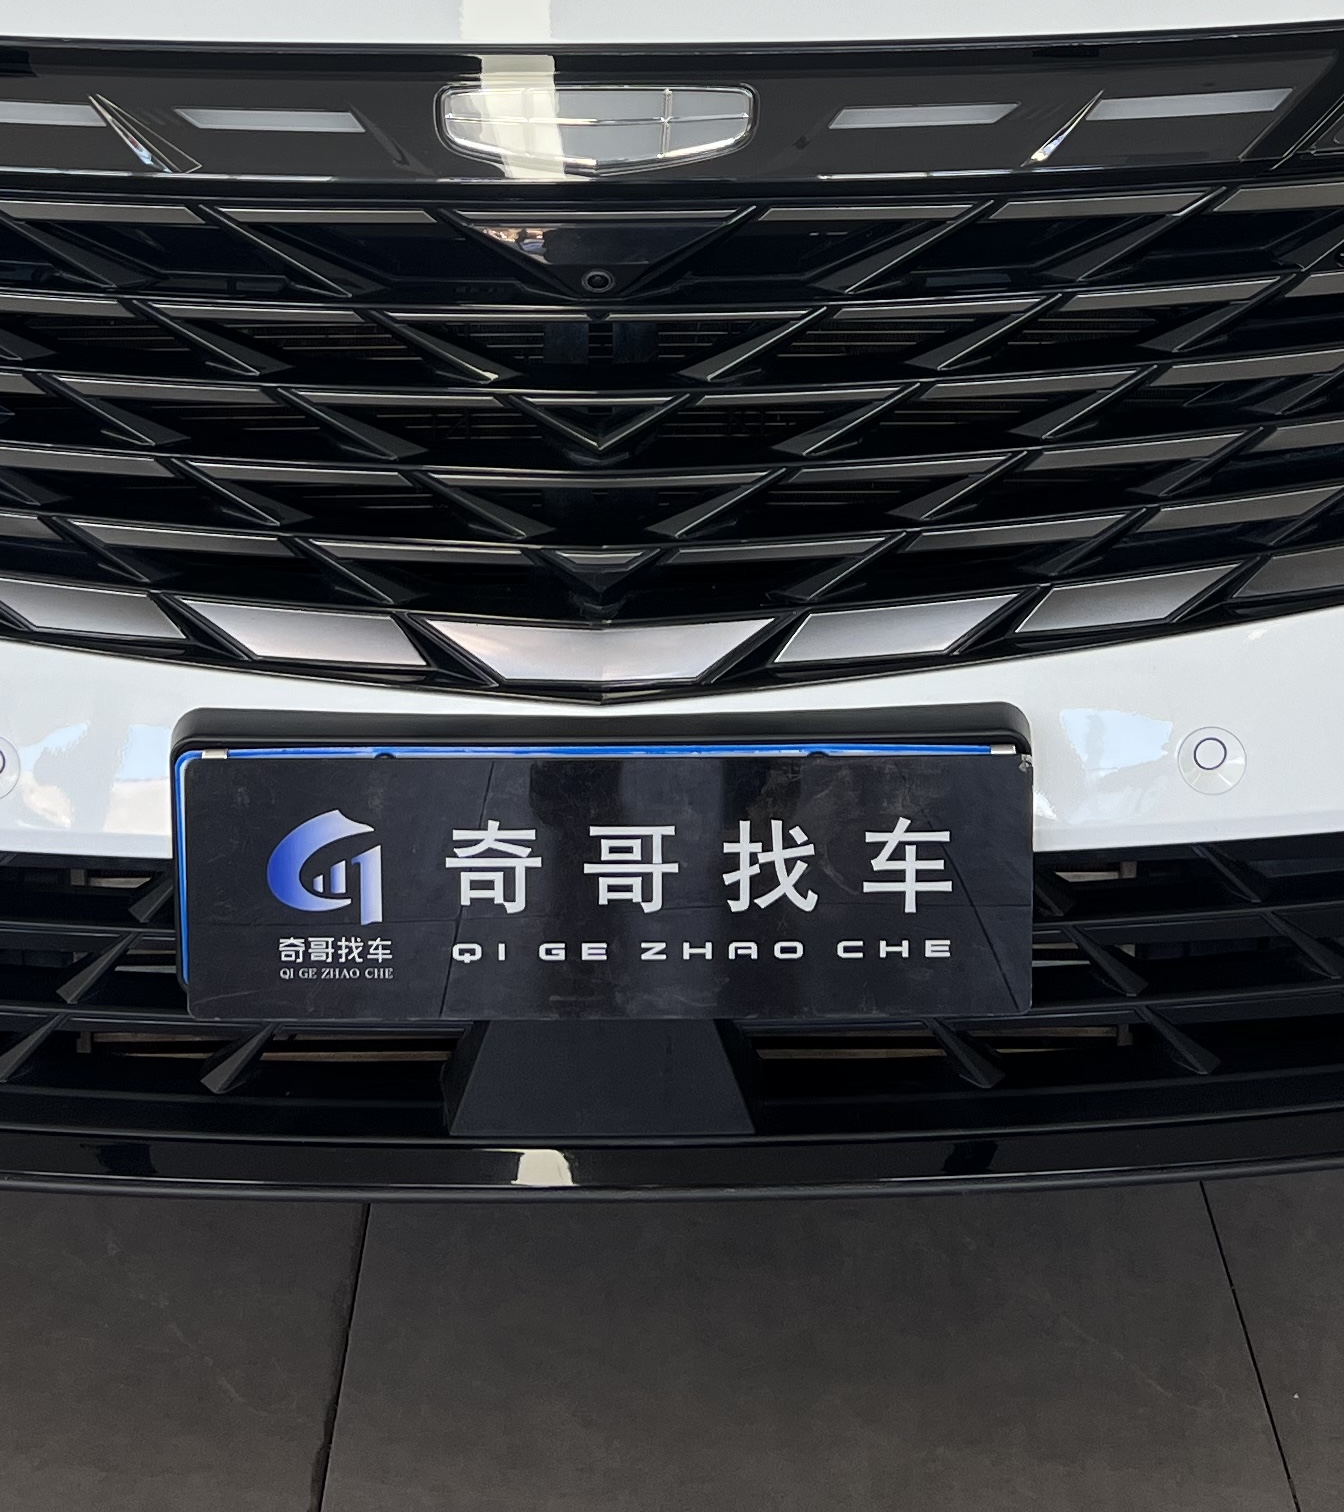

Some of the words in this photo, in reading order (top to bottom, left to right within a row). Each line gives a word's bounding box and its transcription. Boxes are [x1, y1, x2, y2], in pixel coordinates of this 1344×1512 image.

[445, 816, 954, 914] 奇哥找车
[278, 936, 394, 964] 奇哥找车
[452, 939, 507, 964] QI
[538, 942, 608, 961] GE
[640, 941, 804, 960] ZHAO
[836, 939, 952, 959] CHE
[279, 967, 294, 980] QI
[298, 967, 318, 980] GE
[320, 967, 360, 980] ZHAO
[364, 967, 394, 980] CHE
